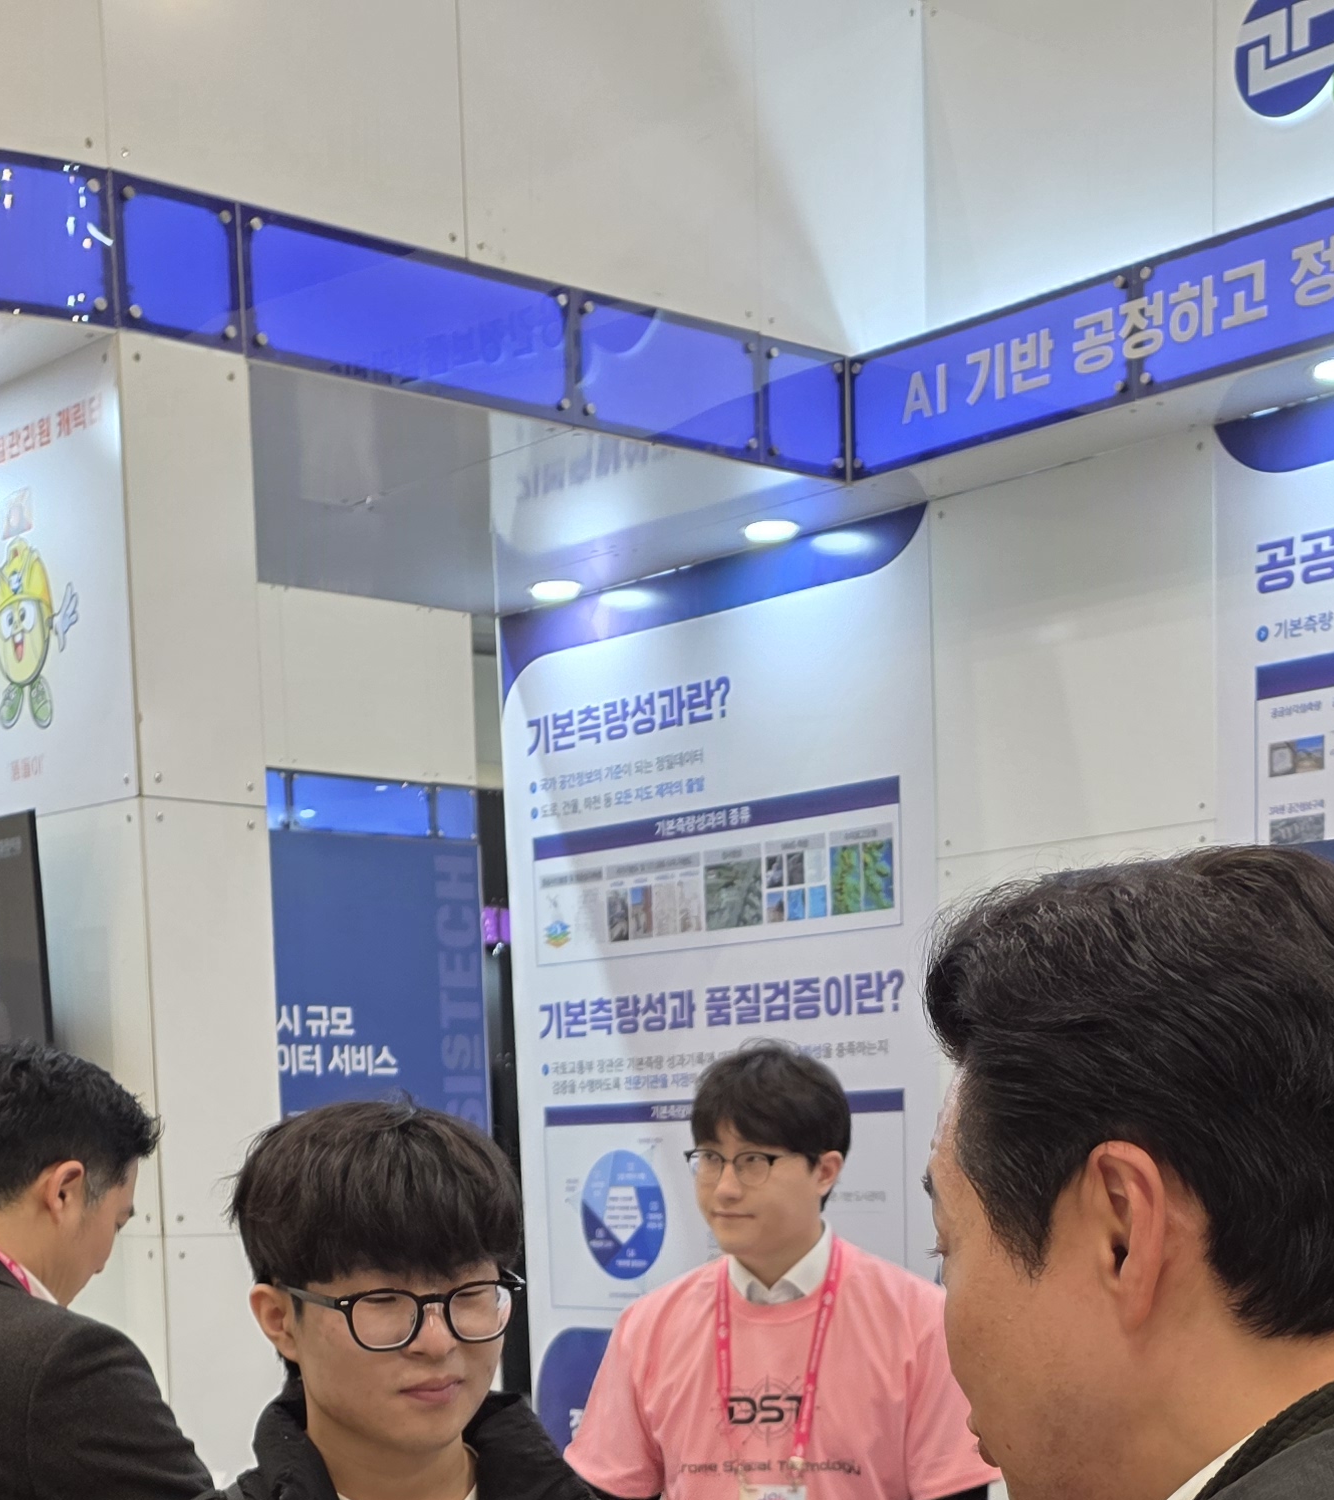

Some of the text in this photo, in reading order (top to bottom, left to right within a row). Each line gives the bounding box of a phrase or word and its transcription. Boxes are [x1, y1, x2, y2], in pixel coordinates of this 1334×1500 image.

[901, 364, 947, 424] AI
[966, 329, 1055, 406] 기반
[1072, 260, 1267, 375] 공정하고
[56, 391, 103, 439] 캐릭터
[1274, 611, 1334, 640] 기본측량
[527, 675, 731, 757] 기본측량성과란?
[654, 805, 751, 837] 기본측량성과의 종류
[305, 1006, 355, 1037] 규모
[538, 968, 905, 1040] 기본측량성과 품질검증이란?
[328, 1045, 399, 1077] 서비스
